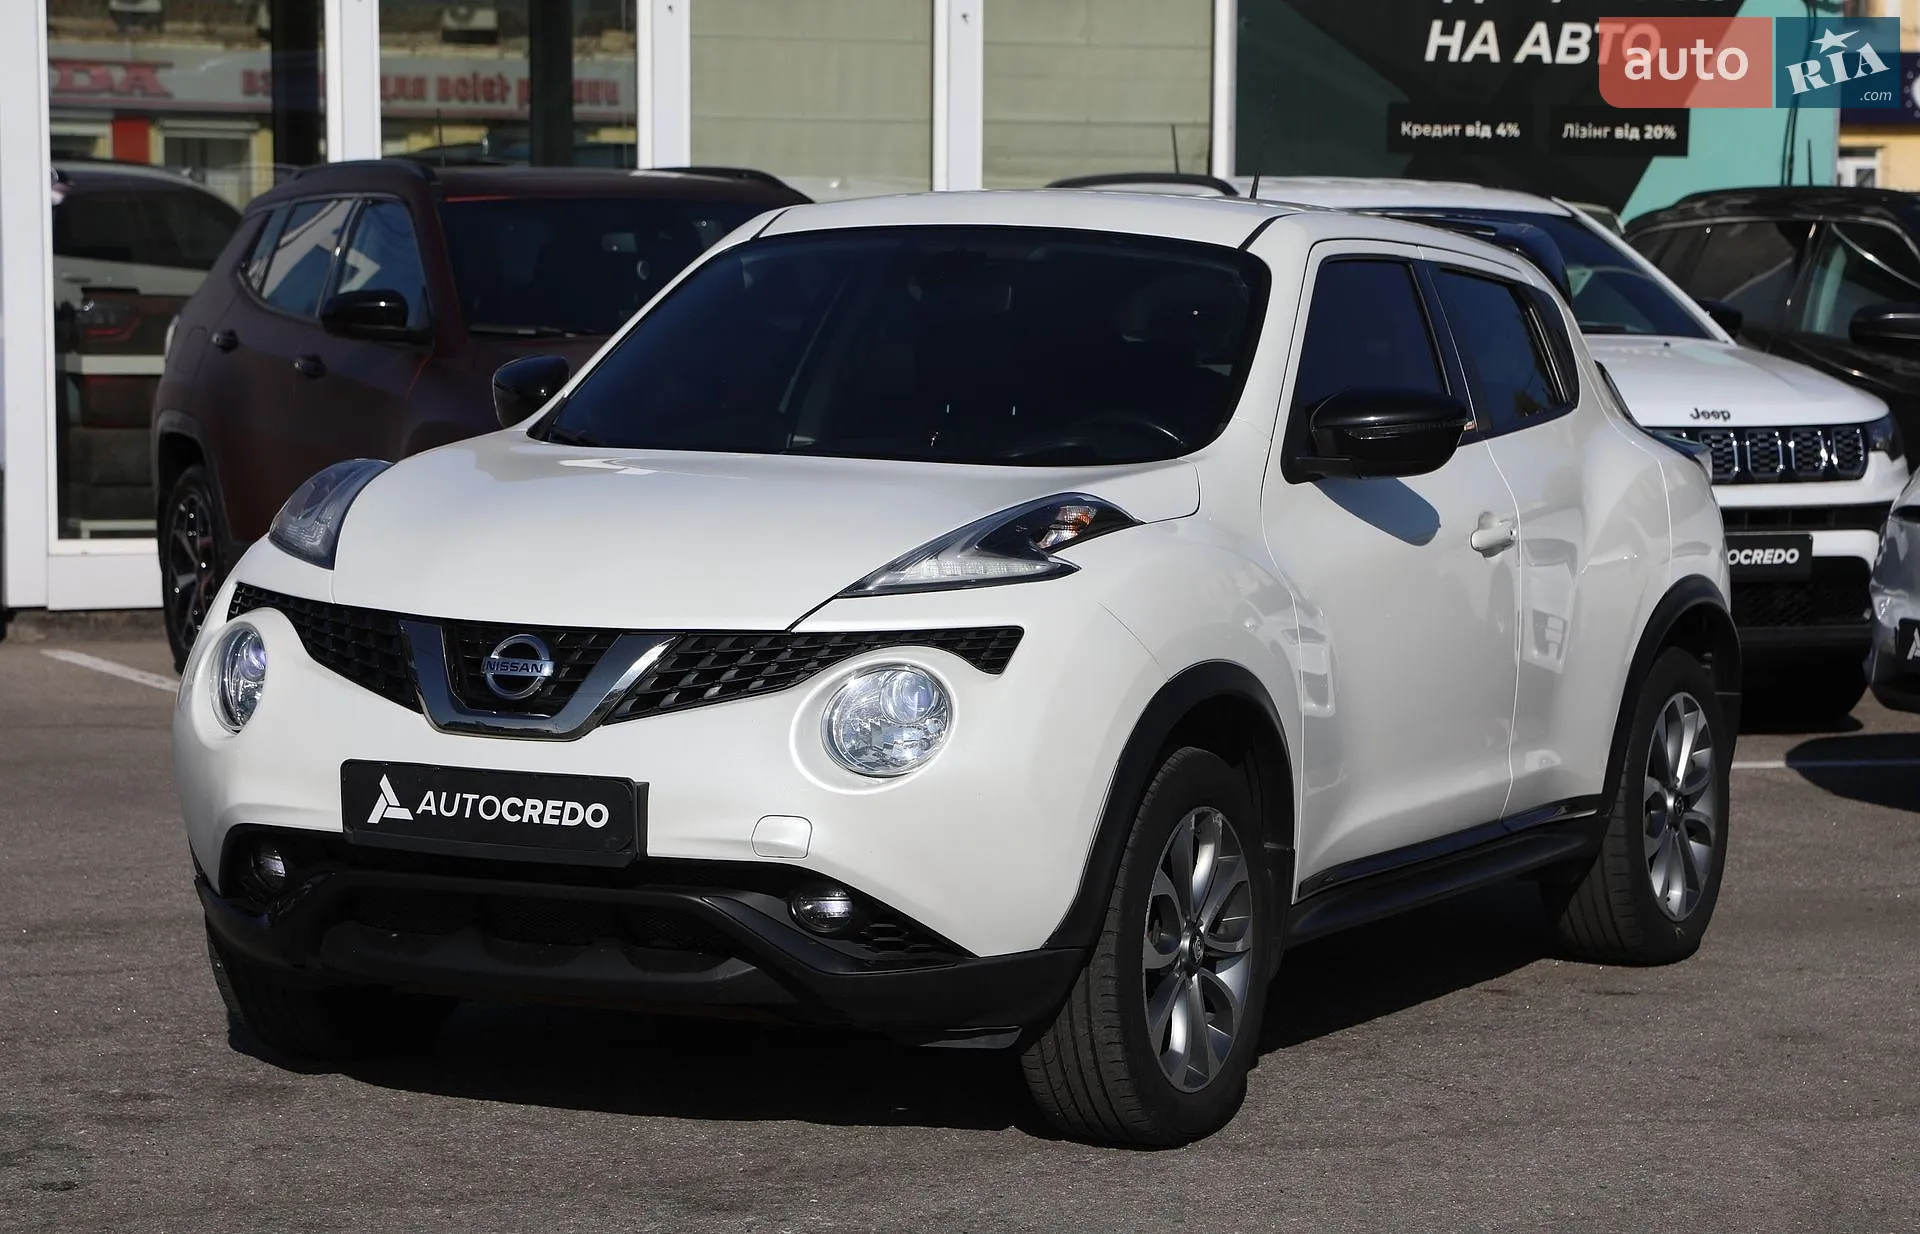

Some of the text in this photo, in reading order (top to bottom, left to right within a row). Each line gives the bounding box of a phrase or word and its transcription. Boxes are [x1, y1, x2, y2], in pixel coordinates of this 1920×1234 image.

[1425, 19, 1662, 65] НА АВТО
[1401, 121, 1520, 138] Кредит від 4%
[1562, 122, 1677, 141] Лізінг від 20%
[1690, 408, 1731, 421] Jeep
[486, 661, 543, 673] NISSAN
[416, 790, 610, 829] AUTOCREDO
